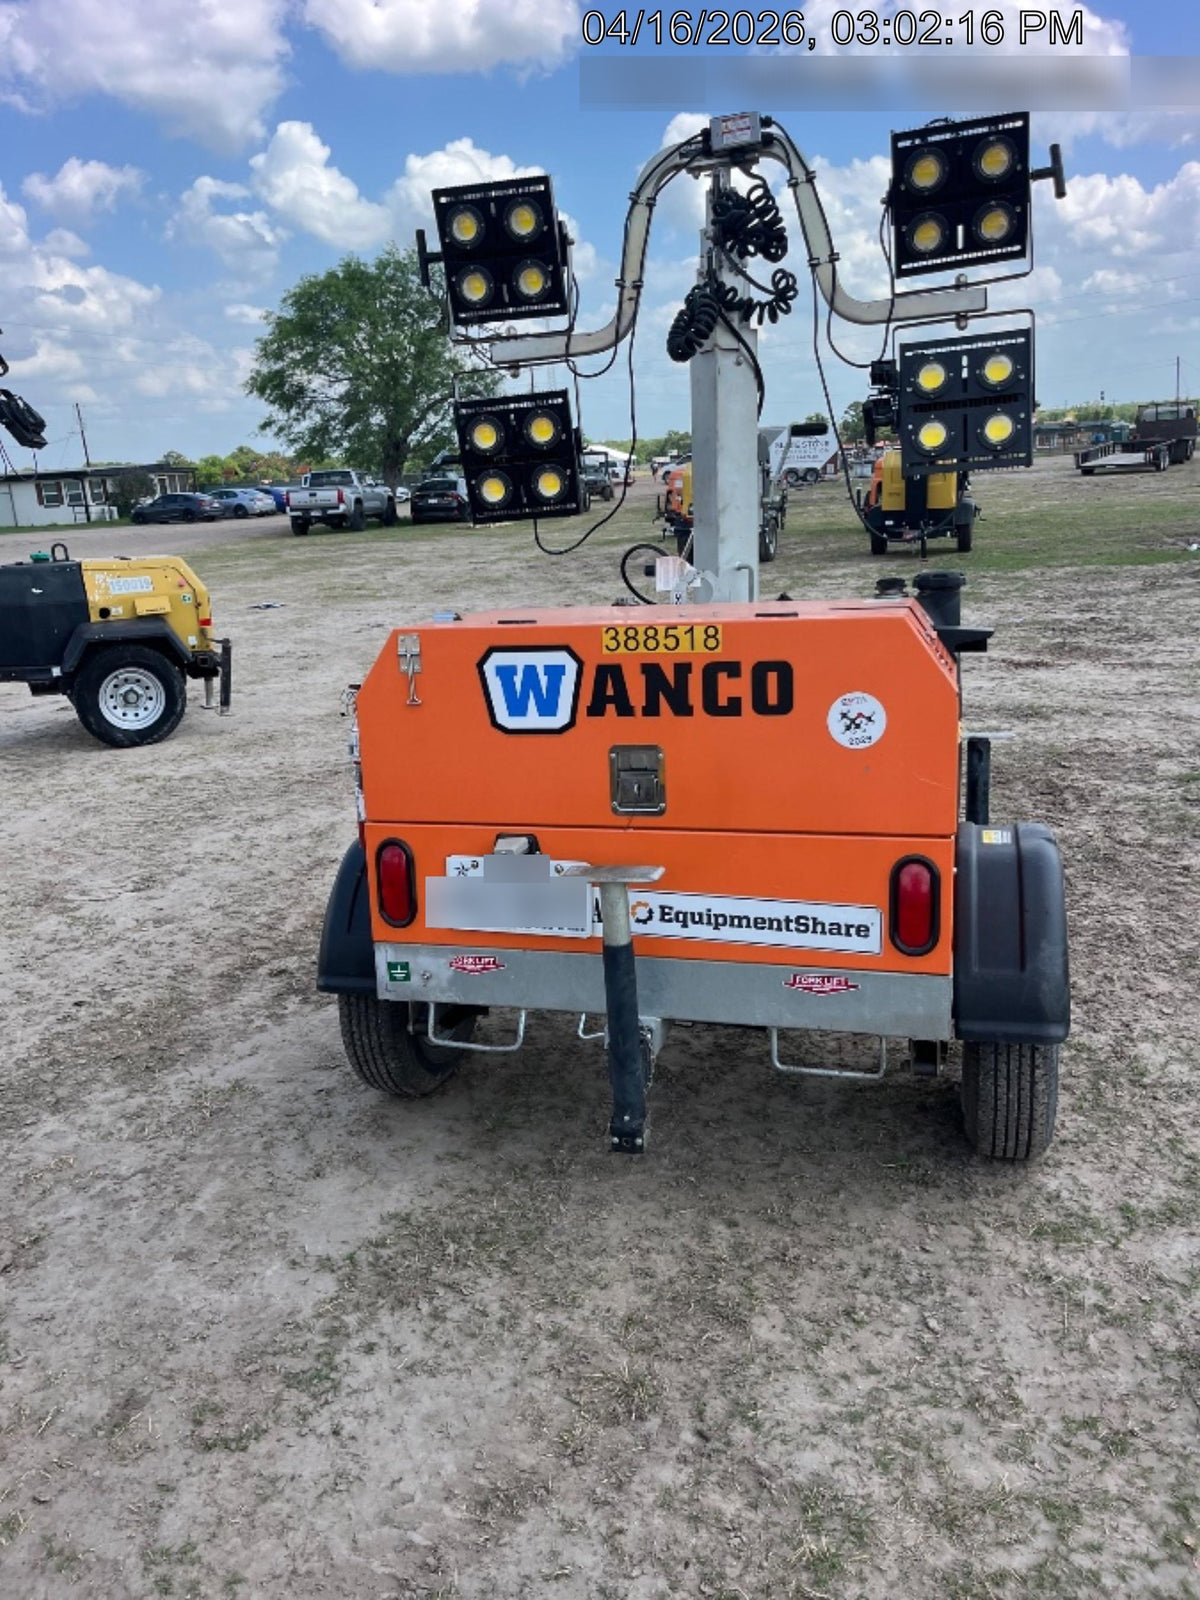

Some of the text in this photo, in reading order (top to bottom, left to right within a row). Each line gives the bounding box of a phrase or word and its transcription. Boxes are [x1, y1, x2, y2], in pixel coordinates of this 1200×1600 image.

[604, 625, 720, 652] 388518
[495, 660, 793, 717] WANCO
[659, 904, 871, 938] EquipmentShare
